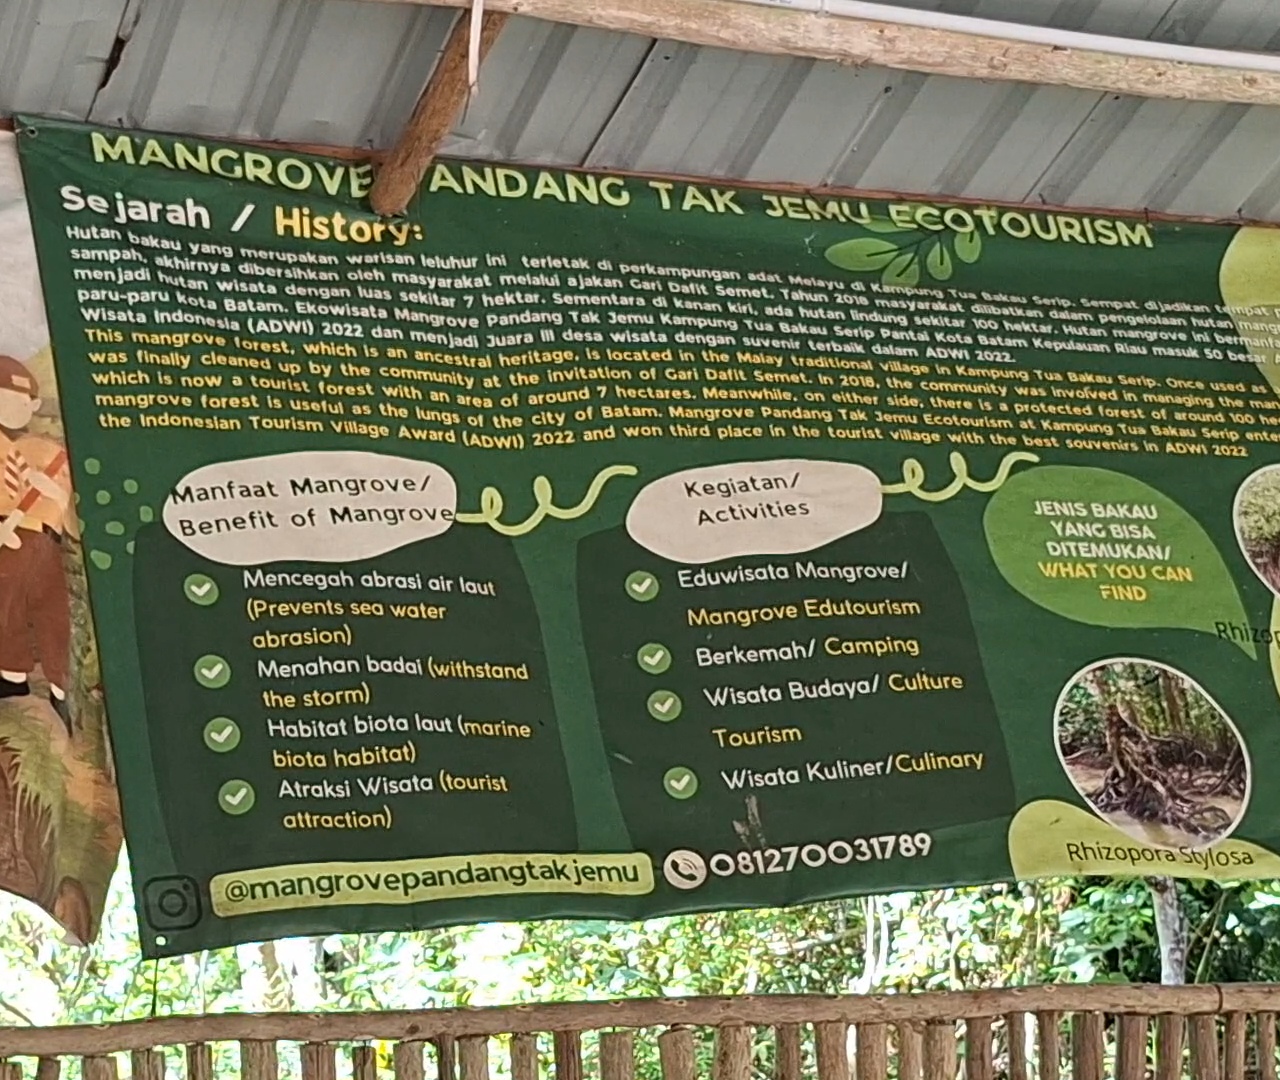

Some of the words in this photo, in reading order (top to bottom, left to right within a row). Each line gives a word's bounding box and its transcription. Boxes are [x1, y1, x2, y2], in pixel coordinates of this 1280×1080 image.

[90, 132, 373, 199] MANGROVE
[429, 162, 631, 207] ANDANG
[649, 181, 745, 215] TAK
[763, 194, 872, 225] JEMU
[888, 204, 1154, 249] ECOTOURISM
[59, 186, 212, 230] Sejarah
[230, 203, 255, 233] /
[274, 206, 424, 246] History:
[66, 225, 122, 242] Hutan
[127, 231, 182, 252] bakau
[188, 241, 234, 259] yang
[239, 246, 339, 268] merupakan
[79, 308, 147, 323] Wisata
[153, 310, 240, 331] Indonesia
[246, 317, 314, 335] (ADWI)
[321, 322, 365, 338] 2022
[371, 326, 404, 340] dan
[410, 330, 479, 349] menjadi
[486, 331, 534, 348] Juara
[562, 329, 603, 342] desa
[609, 330, 668, 343] wisata
[674, 330, 737, 347] dengan
[742, 335, 800, 350] suvenir
[807, 340, 865, 353] terbaik
[871, 343, 919, 357] dalam
[925, 347, 970, 360] ADWI
[99, 413, 132, 428] the
[140, 412, 241, 430] Indonesian
[249, 415, 324, 433] Tourism
[330, 420, 390, 438] Village
[398, 425, 456, 443] Award
[462, 430, 525, 450] (ADWI)
[532, 431, 576, 446] 2022
[582, 426, 616, 441] and
[622, 426, 664, 438] won
[669, 423, 711, 438] third
[717, 425, 763, 441] place
[768, 424, 786, 437] in
[791, 424, 820, 438] the
[827, 425, 883, 440] tourist
[890, 428, 940, 444] village
[946, 431, 983, 446] with
[989, 433, 1018, 446] the
[1024, 434, 1060, 449] best
[1143, 439, 1160, 452] in
[1165, 440, 1210, 455] ADWI
[1213, 444, 1249, 457] 2022
[170, 478, 279, 505] Manfaat
[289, 475, 433, 498] Mangrove/
[684, 472, 802, 498] Kegiatan/
[178, 507, 279, 538] Benefit
[290, 505, 317, 528] of
[330, 502, 457, 526] Mangrove
[696, 500, 811, 527] Activities
[1033, 499, 1088, 518] JENIS
[1091, 502, 1159, 521] BAKAU
[1050, 520, 1106, 540] YANG
[1110, 521, 1157, 541] BISA
[1046, 539, 1172, 561] DITEMUKAN/
[242, 569, 355, 591] Mencegah
[359, 571, 423, 592] abrasi
[428, 577, 455, 594] air
[459, 576, 496, 597] laut
[677, 563, 790, 590] Eduwisata
[795, 561, 908, 584] Mangrove/
[1037, 561, 1101, 582] WHAT
[1103, 562, 1146, 582] YOU
[1150, 565, 1194, 584] CAN
[1099, 583, 1147, 602] FIND
[246, 597, 345, 621] (Prevents
[349, 602, 385, 617] sea
[389, 602, 447, 621] water
[686, 603, 799, 629] Mangrove
[803, 597, 922, 620] Edutourism
[252, 625, 353, 649] abrasion)
[695, 638, 817, 668] Berkemah/
[824, 636, 921, 657] Camping
[257, 656, 361, 679] Menahan
[365, 655, 424, 676] badai
[427, 657, 530, 681] (withstand
[262, 690, 296, 709] the
[303, 682, 371, 708] storm)
[703, 685, 783, 709] Wisata
[789, 673, 881, 702] Budaya/
[887, 672, 964, 694] Culture
[267, 717, 348, 739] Habitat
[353, 714, 410, 736] biota
[415, 713, 454, 735] laut
[456, 715, 532, 739] (marine
[712, 724, 803, 750] Tourism
[272, 748, 327, 769] biota
[333, 741, 417, 767] habitat)
[278, 778, 352, 800] Atraksi
[357, 774, 434, 797] Wisata
[438, 769, 509, 795] (tourist
[720, 768, 800, 792] Wisata
[282, 804, 393, 831] attraction)
[709, 831, 933, 879] 081270031789
[1066, 841, 1176, 871] Rhizopora
[1178, 846, 1255, 870] Stylosa
[224, 862, 639, 903] @mangrovepandangtakjemu
